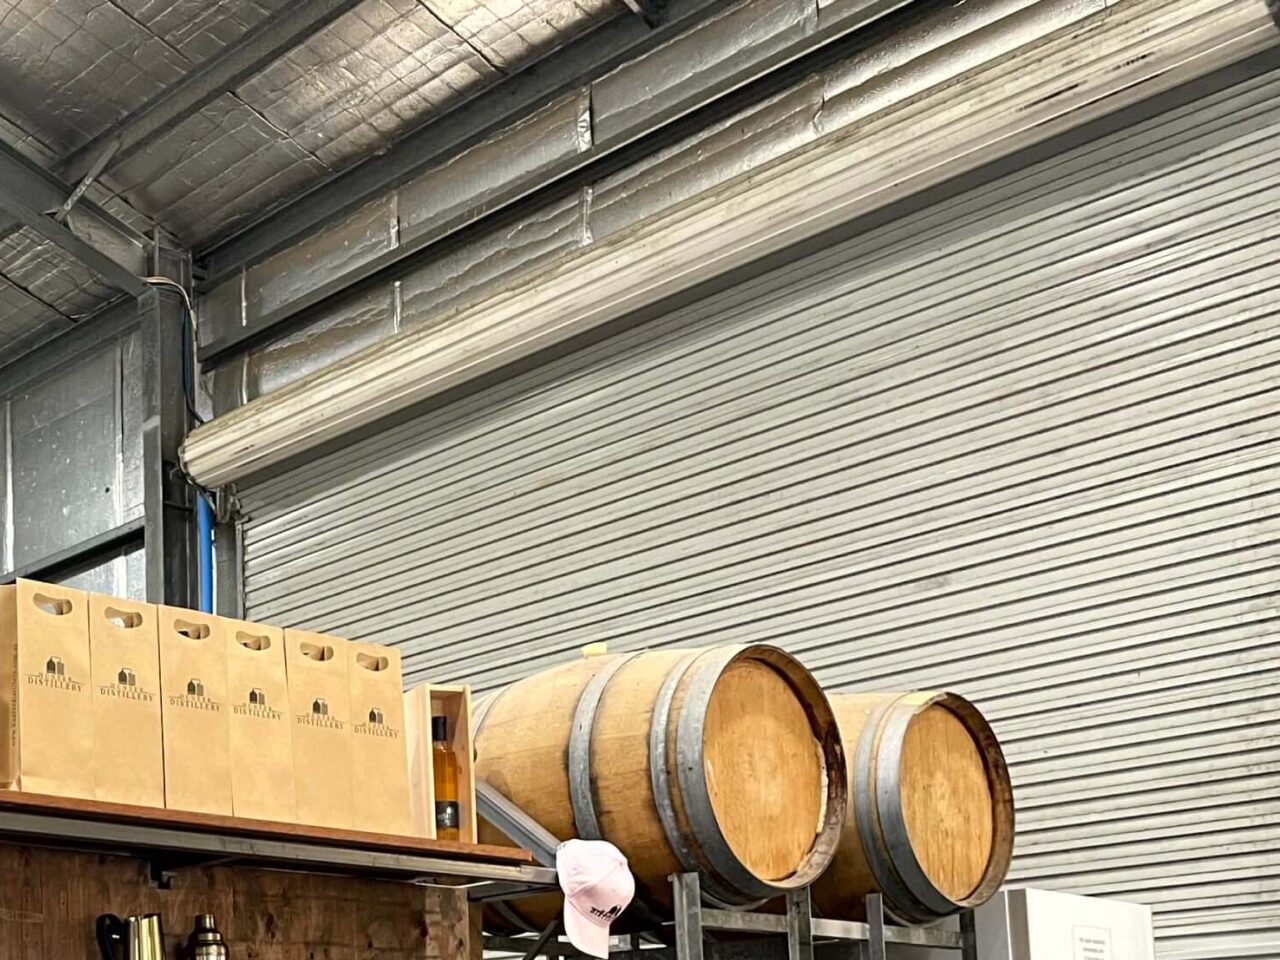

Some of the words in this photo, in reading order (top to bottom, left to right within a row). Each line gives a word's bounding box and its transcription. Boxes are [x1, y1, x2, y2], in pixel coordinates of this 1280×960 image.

[27, 676, 82, 692] DISTILLERY
[100, 688, 153, 702] DISTILLERY
[170, 699, 220, 712] DISTILLERY
[233, 706, 282, 721] DISTILLERY
[297, 717, 344, 730] DISTILLERY
[354, 726, 398, 739] DISTILLERY
